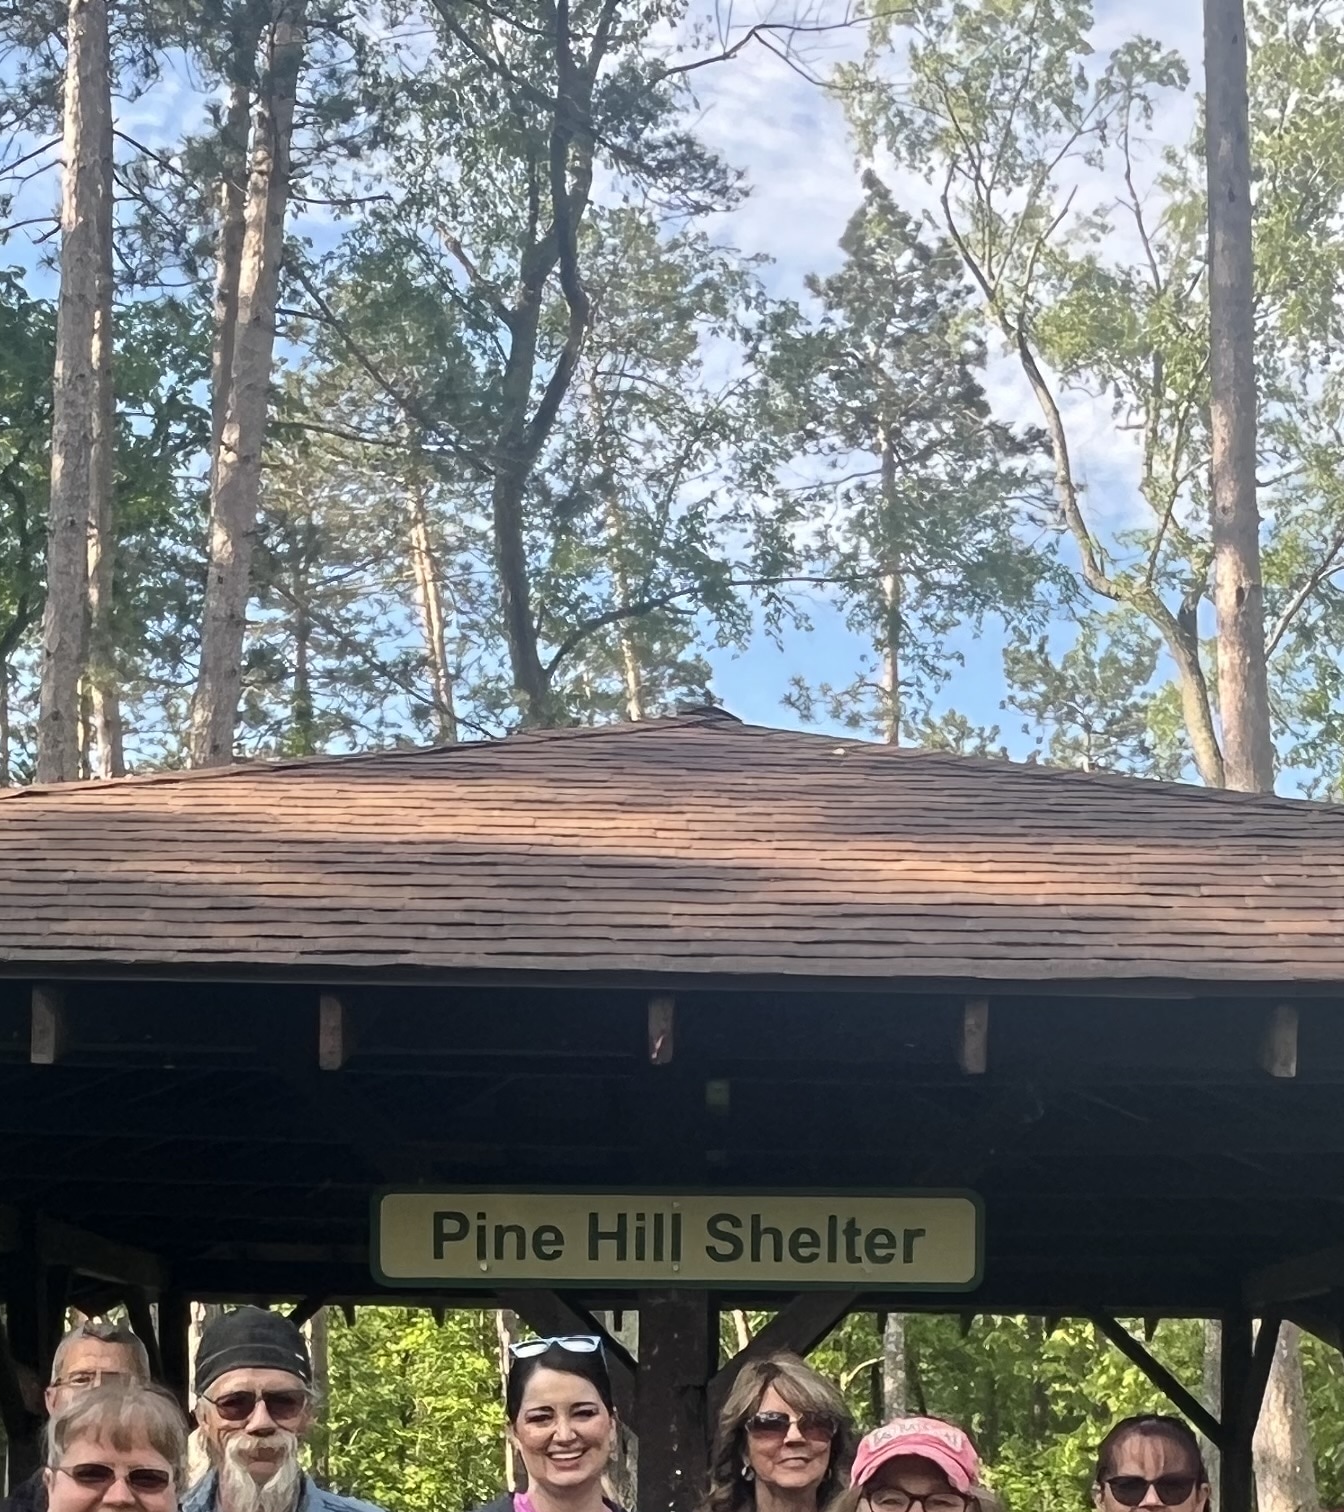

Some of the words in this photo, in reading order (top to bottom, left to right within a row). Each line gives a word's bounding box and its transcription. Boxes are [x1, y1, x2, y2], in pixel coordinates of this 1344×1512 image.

[433, 1211, 565, 1262] Pine
[588, 1211, 683, 1263] Hill
[705, 1213, 926, 1265] Shelter
